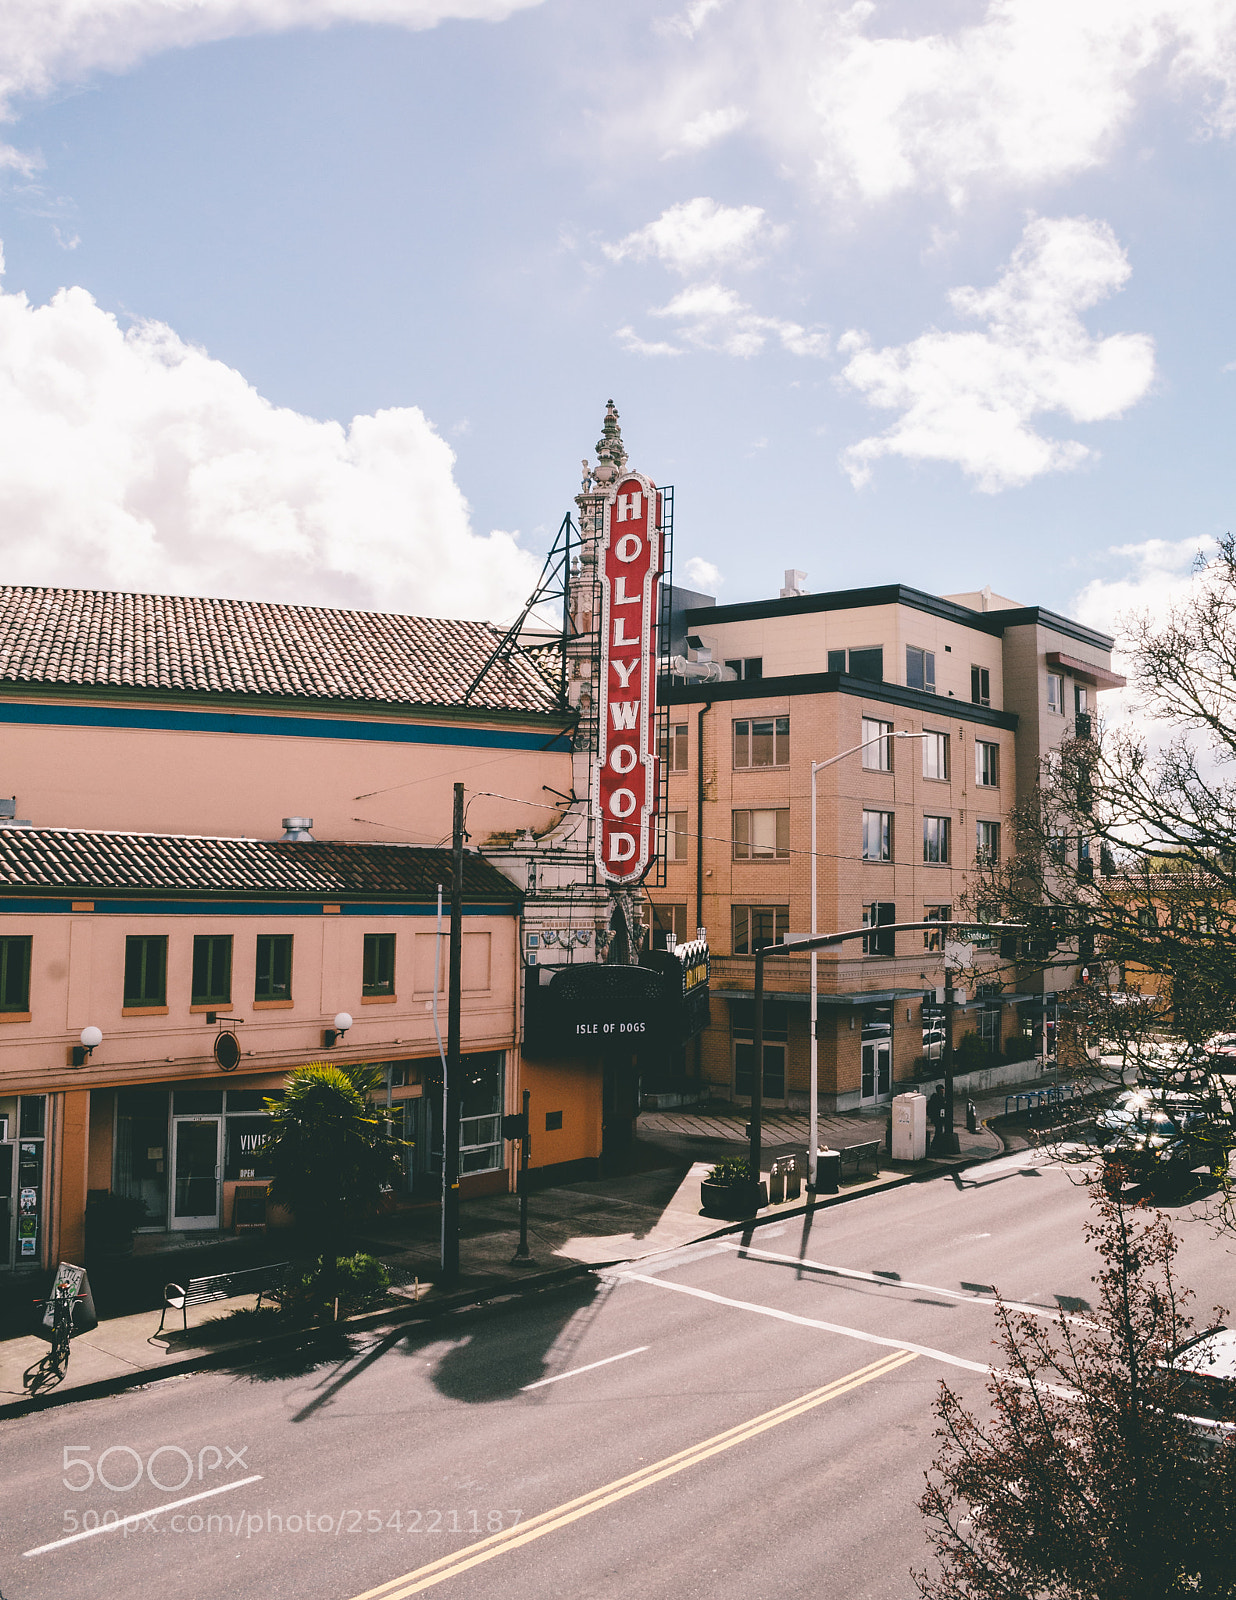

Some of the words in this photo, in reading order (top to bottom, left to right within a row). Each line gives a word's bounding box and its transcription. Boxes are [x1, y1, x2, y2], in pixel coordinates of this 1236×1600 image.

[608, 491, 643, 862] HOLLYWOOD
[576, 1024, 598, 1034] ISLE
[603, 1023, 615, 1034] OF
[620, 1022, 646, 1032] DOGS
[240, 1169, 255, 1178] OPEN
